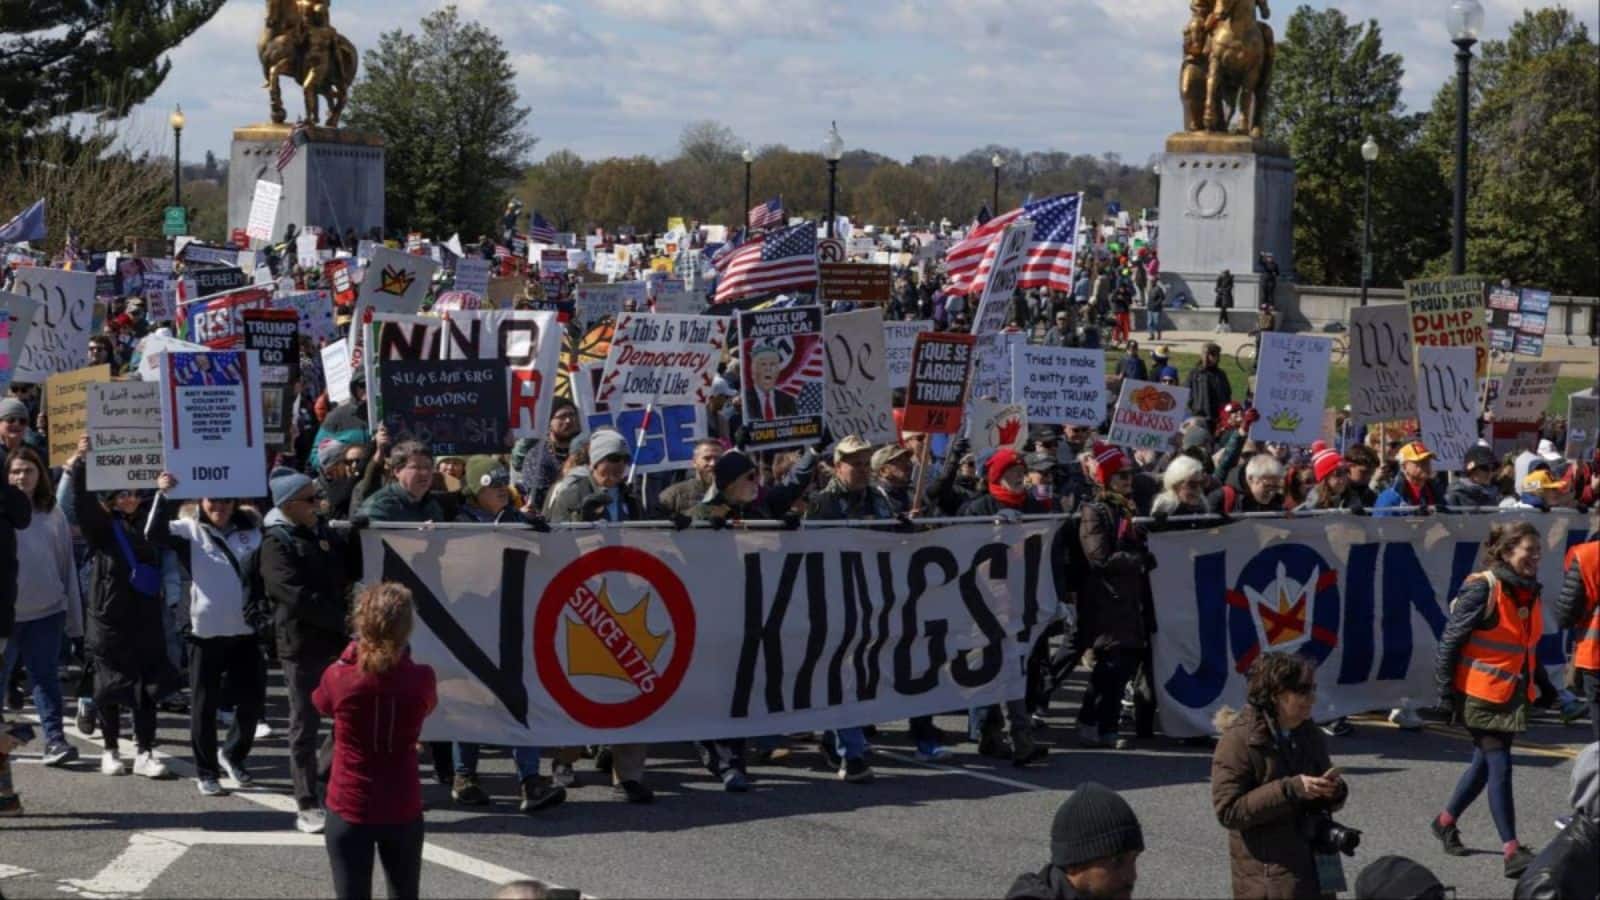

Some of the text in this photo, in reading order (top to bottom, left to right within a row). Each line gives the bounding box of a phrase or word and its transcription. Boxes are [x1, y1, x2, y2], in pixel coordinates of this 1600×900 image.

[1411, 296, 1449, 312] PROUD
[754, 311, 808, 325] WAKE UP
[1412, 310, 1473, 332] DUMP
[246, 321, 296, 335] TRUMP
[632, 318, 711, 343] This Is What
[750, 322, 813, 337] AMERICA!
[1414, 325, 1484, 347] TRAITOR
[252, 336, 292, 349] MUST
[1356, 322, 1408, 369] We
[262, 350, 284, 363] GO
[616, 344, 711, 374] Democracy
[951, 345, 968, 362] SE
[1023, 353, 1096, 369] Tried to make
[915, 363, 966, 382] LARGUE
[1039, 371, 1067, 386] witty
[622, 371, 660, 394] Looks
[663, 372, 690, 395] Like
[1422, 363, 1470, 413] We
[415, 391, 480, 407] LOADING
[916, 383, 961, 402] TRUMP
[1061, 390, 1098, 402] TRUMP
[1027, 406, 1061, 418] CAN'T
[1065, 408, 1097, 422] READ.
[1114, 408, 1174, 433] CONGRESS
[96, 455, 125, 466] RESIGN
[129, 454, 144, 465] MR
[192, 466, 230, 480] IDIOT
[730, 533, 1042, 718] KINGS!
[1164, 541, 1482, 709] JOIN
[569, 586, 657, 693] SINCE 1776
